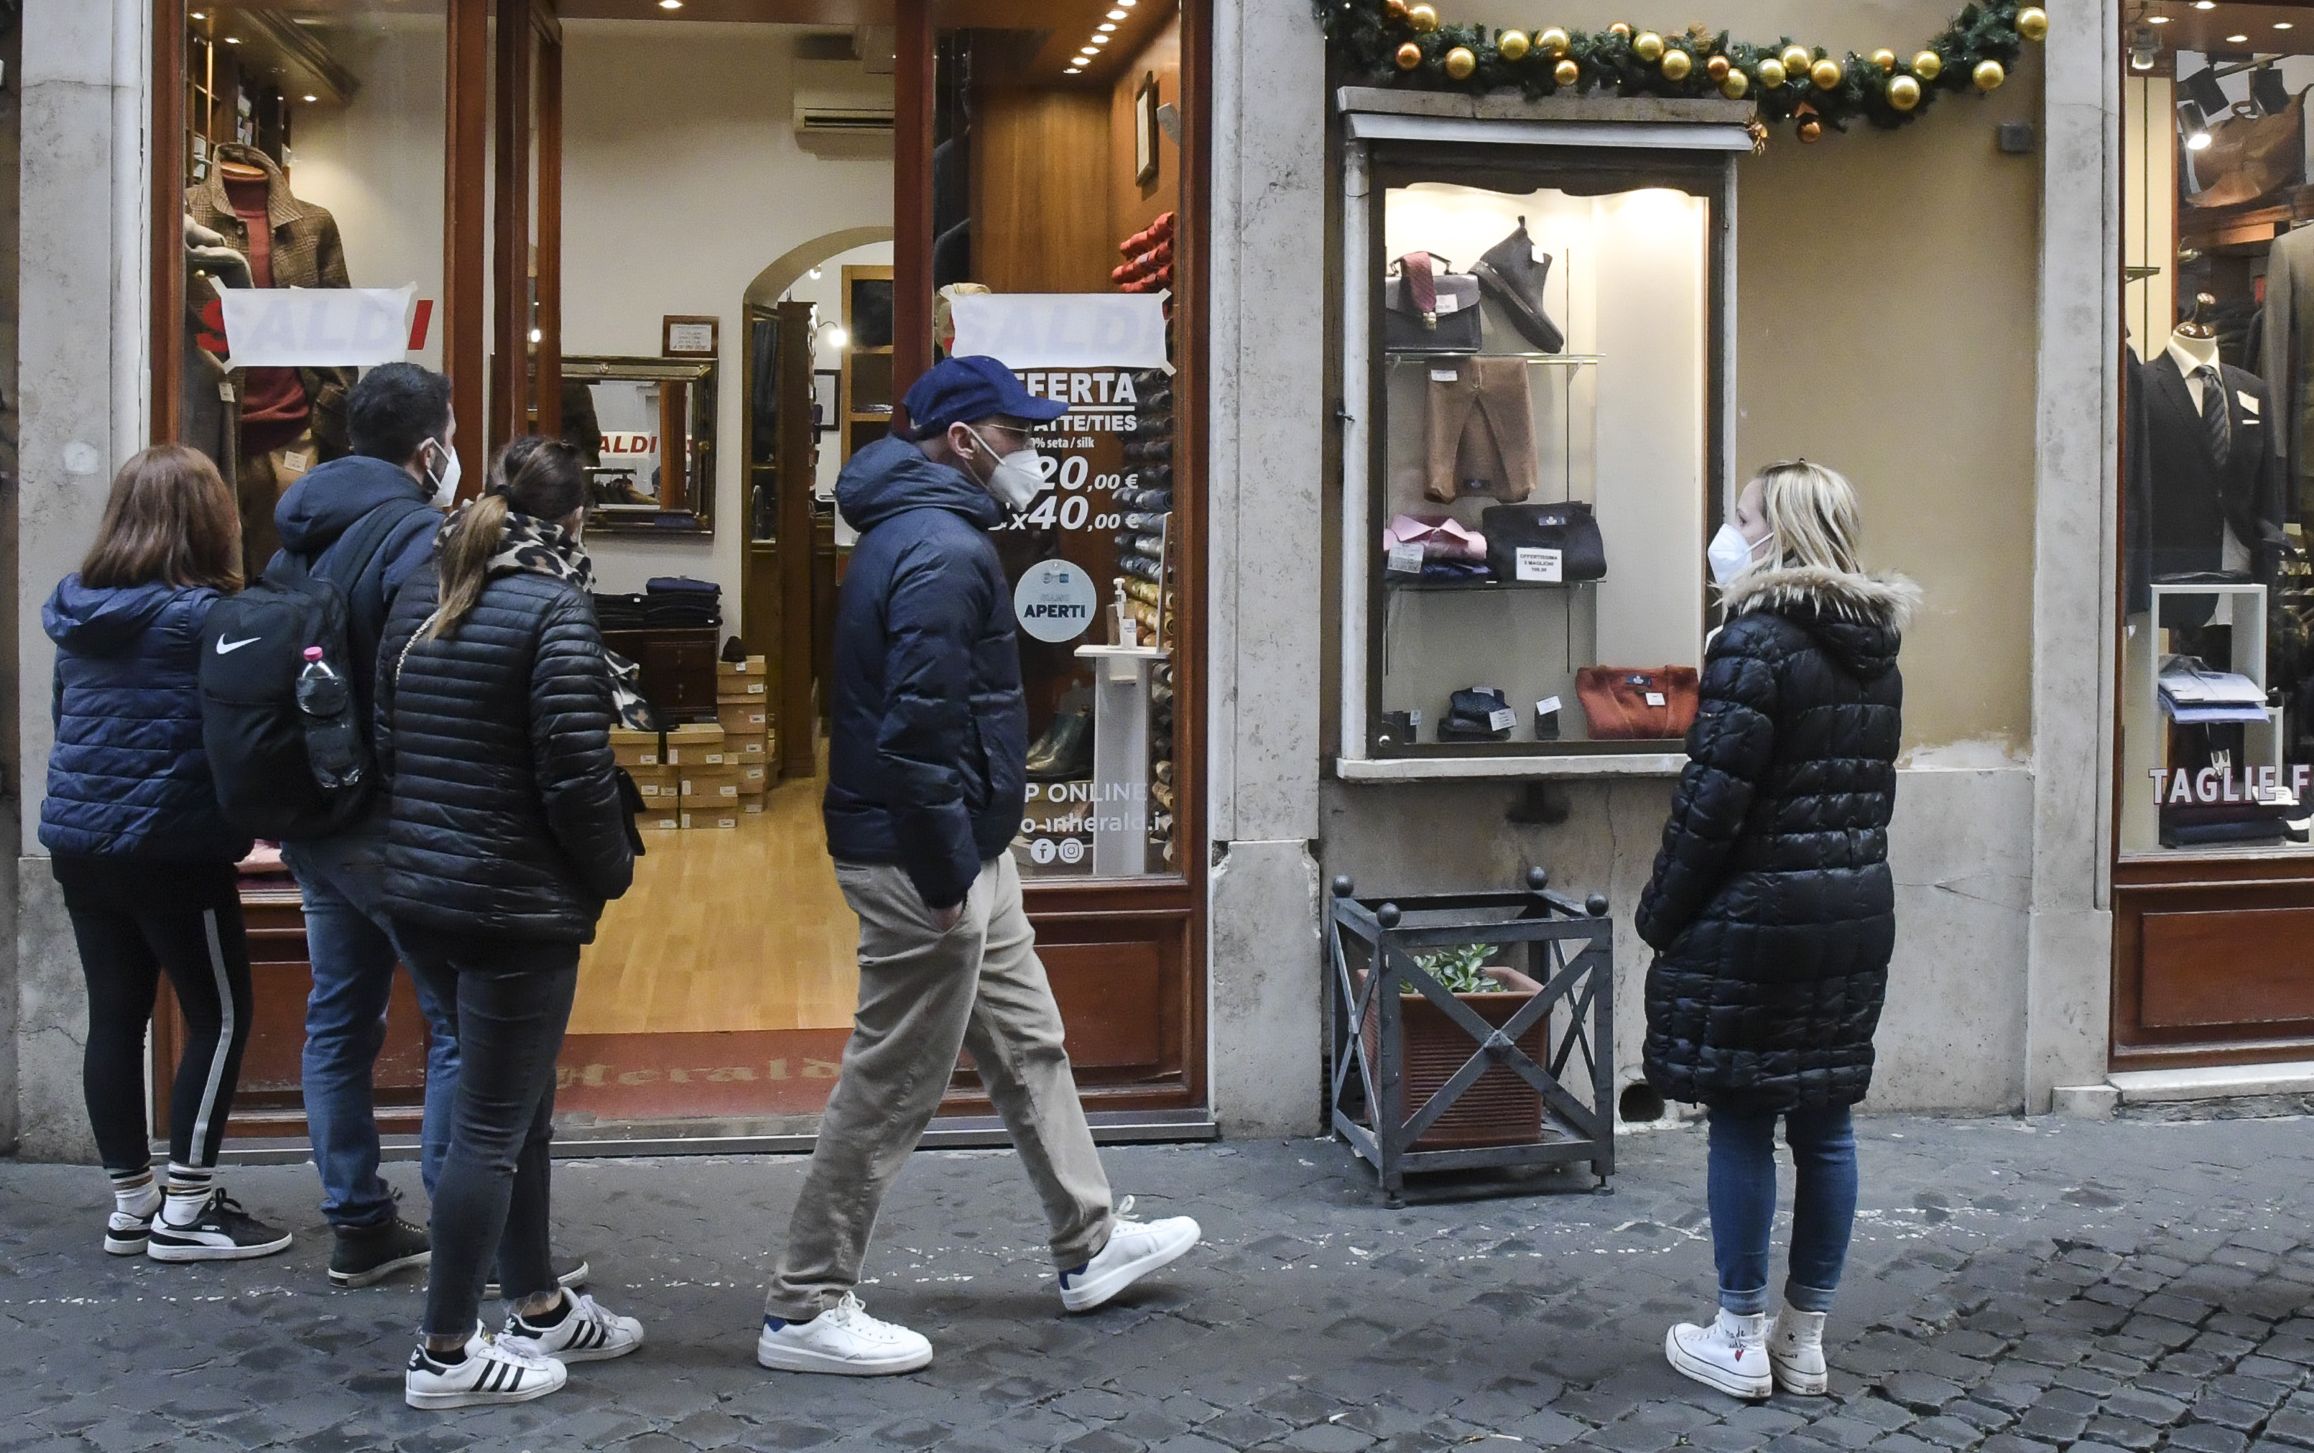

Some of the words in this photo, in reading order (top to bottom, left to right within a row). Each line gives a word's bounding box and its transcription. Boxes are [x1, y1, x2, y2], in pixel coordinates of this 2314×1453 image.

[598, 435, 658, 454] ALDI
[1047, 437, 1069, 449] seta
[1076, 436, 1095, 449] silk
[1125, 474, 1139, 490] €
[1124, 513, 1139, 529] €
[1024, 604, 1086, 618] APERTI
[2148, 765, 2277, 805] TAGLIE
[2292, 764, 2311, 800] F
[1025, 783, 1040, 803] P
[1048, 783, 1148, 803] ONLINE
